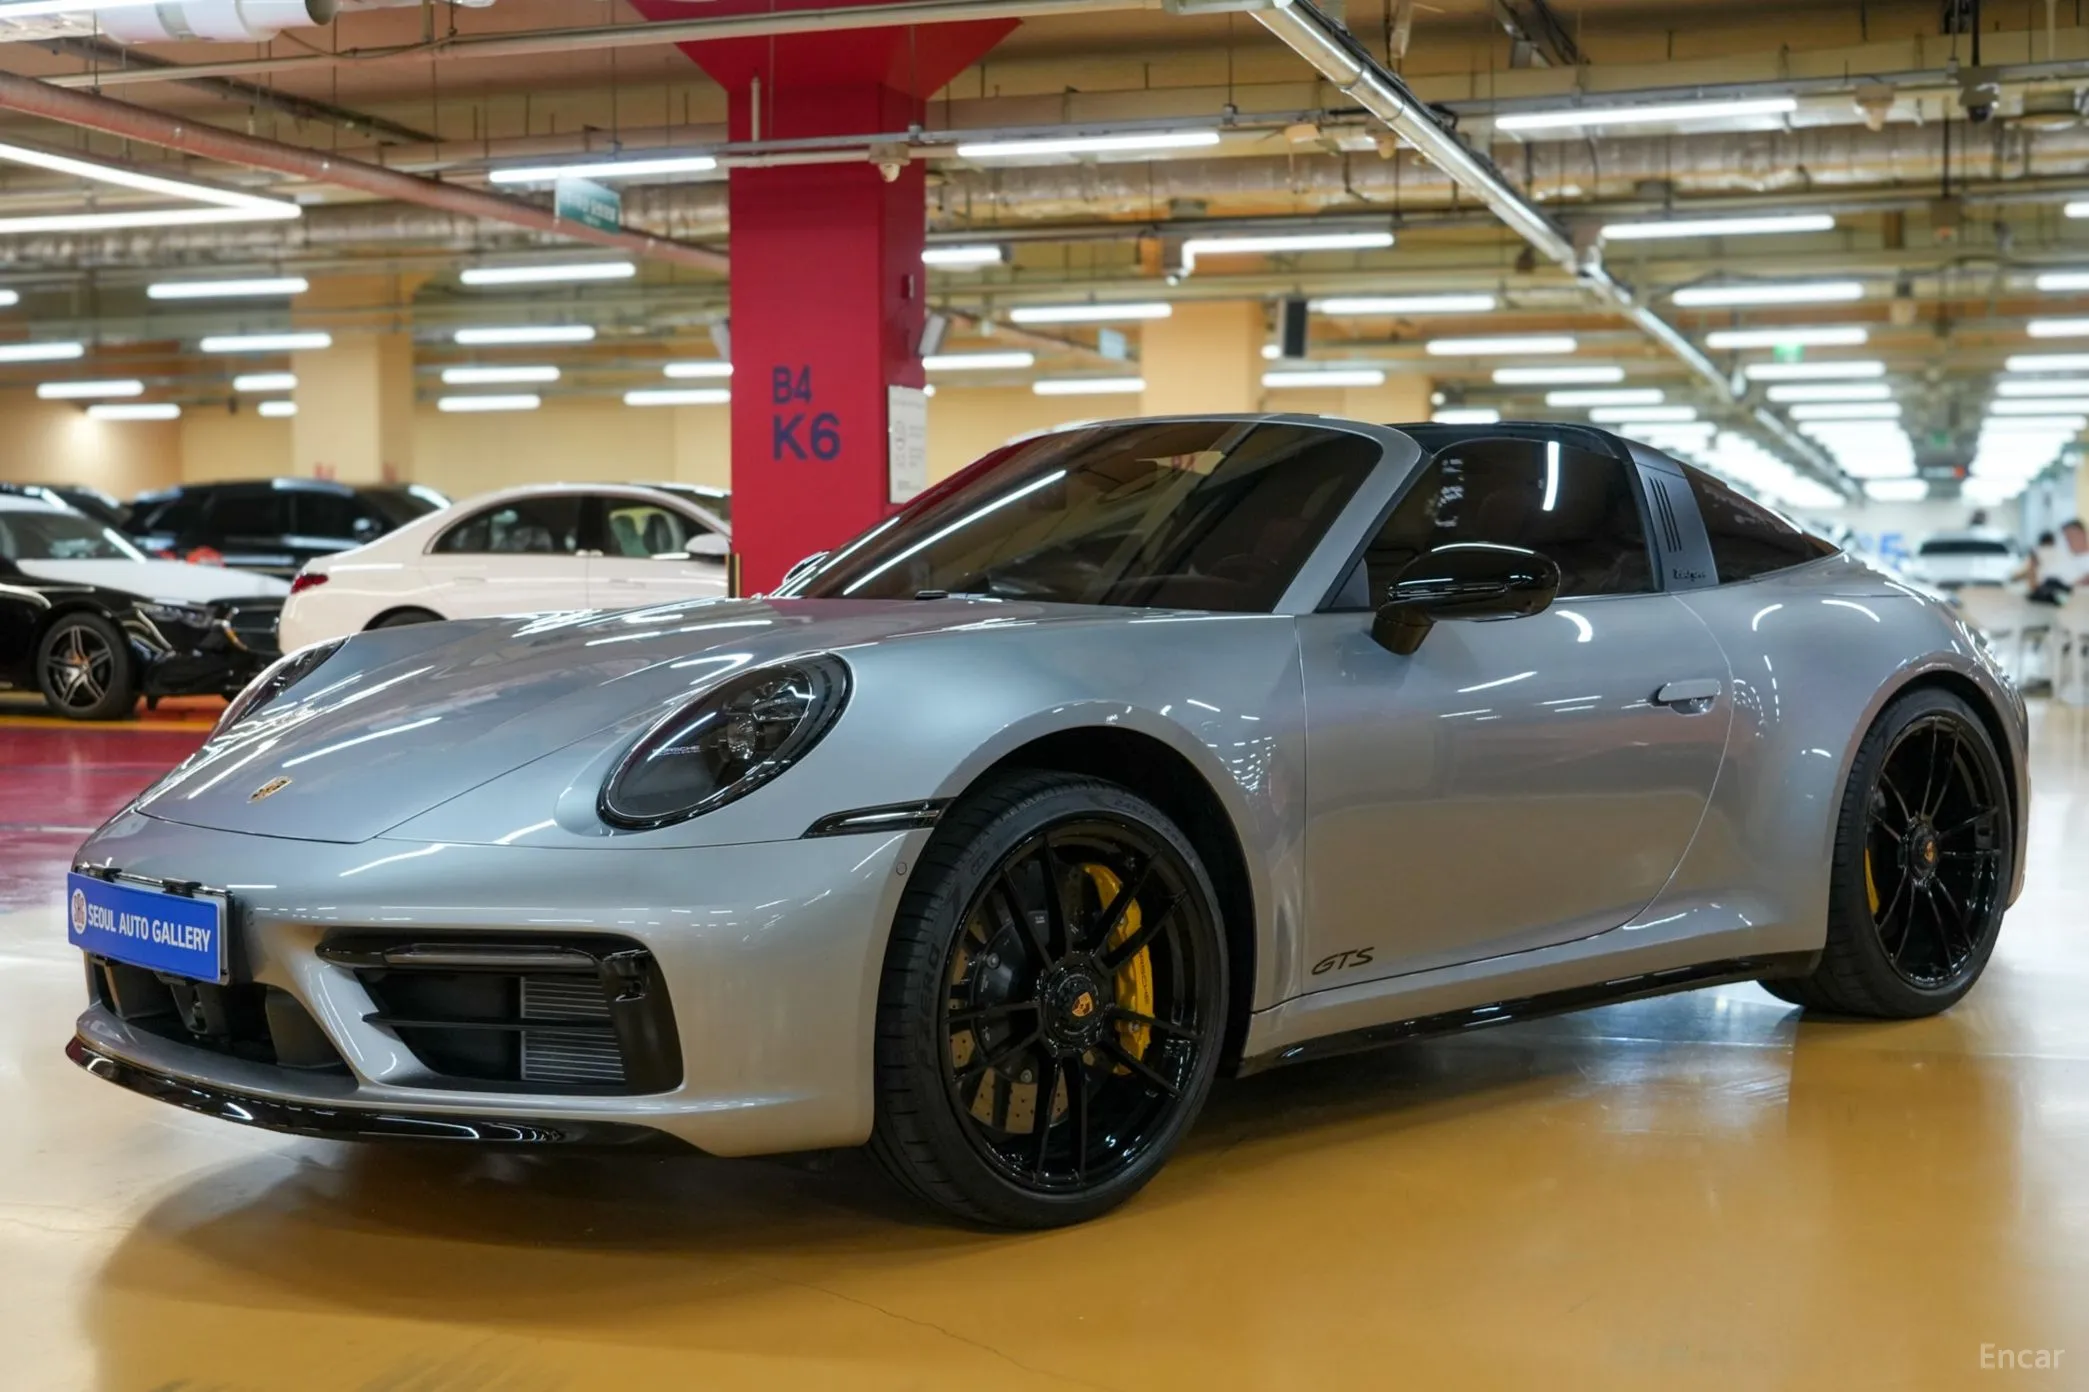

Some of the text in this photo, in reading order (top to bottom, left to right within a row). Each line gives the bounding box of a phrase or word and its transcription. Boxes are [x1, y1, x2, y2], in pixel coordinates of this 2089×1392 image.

[772, 364, 812, 404] B4
[772, 412, 841, 461] K6
[88, 904, 211, 952] SEOUL AUTO GALLERY
[1311, 946, 1375, 975] GTS
